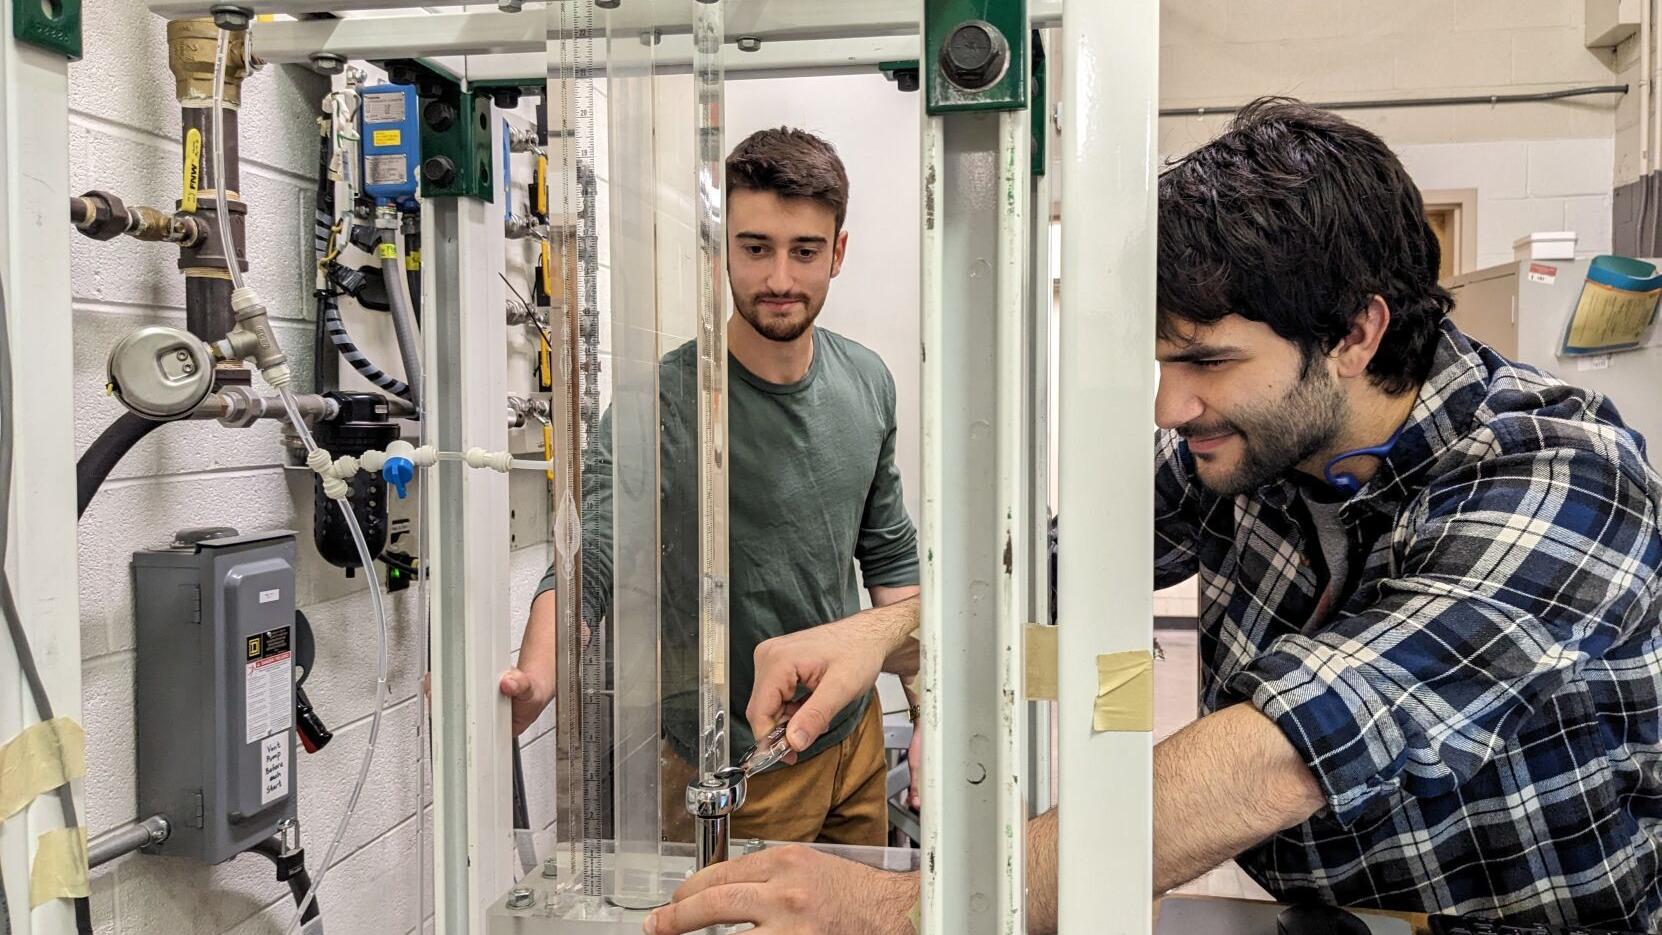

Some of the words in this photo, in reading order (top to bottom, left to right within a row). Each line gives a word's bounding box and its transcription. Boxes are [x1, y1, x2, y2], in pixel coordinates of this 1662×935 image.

[580, 109, 588, 117] 20
[581, 149, 588, 157] 19
[190, 163, 198, 190] FNW
[266, 751, 281, 763] Pump
[266, 780, 282, 794] Start
